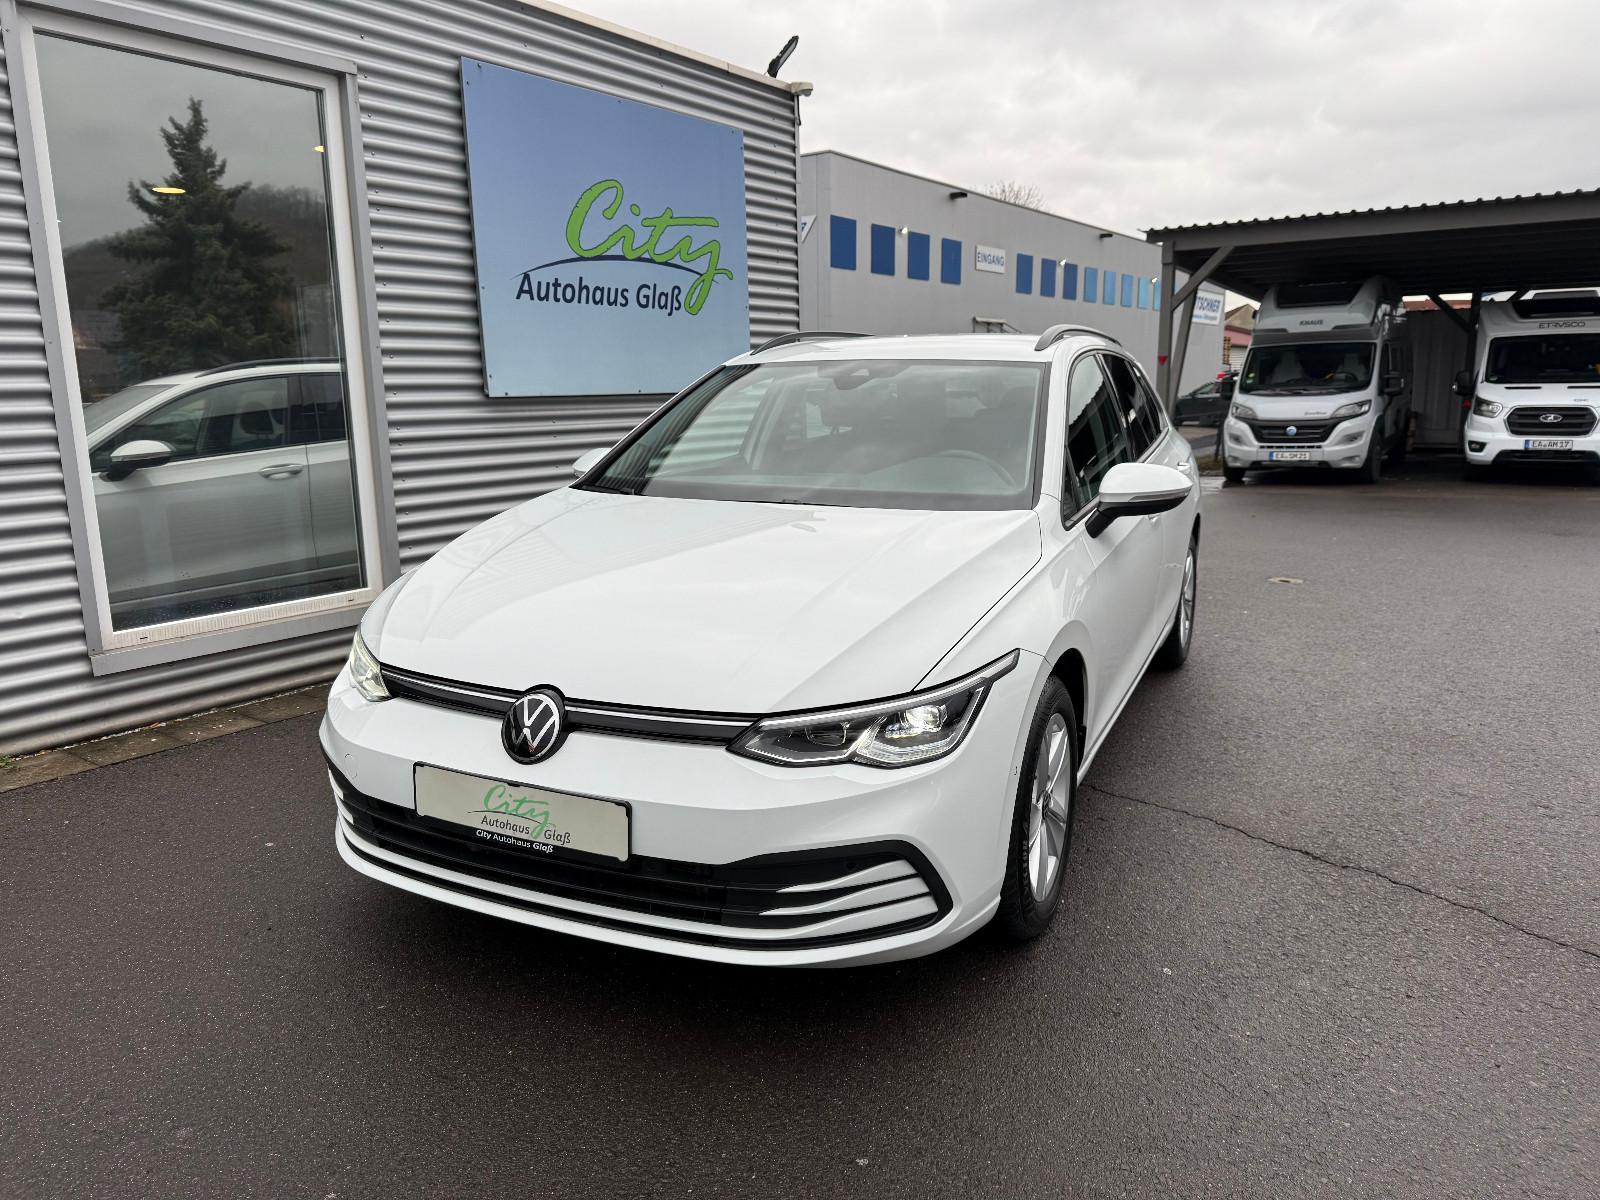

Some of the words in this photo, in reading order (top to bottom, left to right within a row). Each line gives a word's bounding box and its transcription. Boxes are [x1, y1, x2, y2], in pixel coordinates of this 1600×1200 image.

[566, 179, 733, 315] City
[977, 252, 1004, 266] EINGANG
[516, 273, 629, 308] Autohaus
[636, 283, 681, 316] Glaß
[481, 815, 530, 835] Autohaus
[544, 829, 571, 844] Glaß
[484, 785, 555, 839] City
[476, 829, 492, 840] City
[492, 831, 531, 848] Autohaus
[533, 842, 554, 853] Glaß
